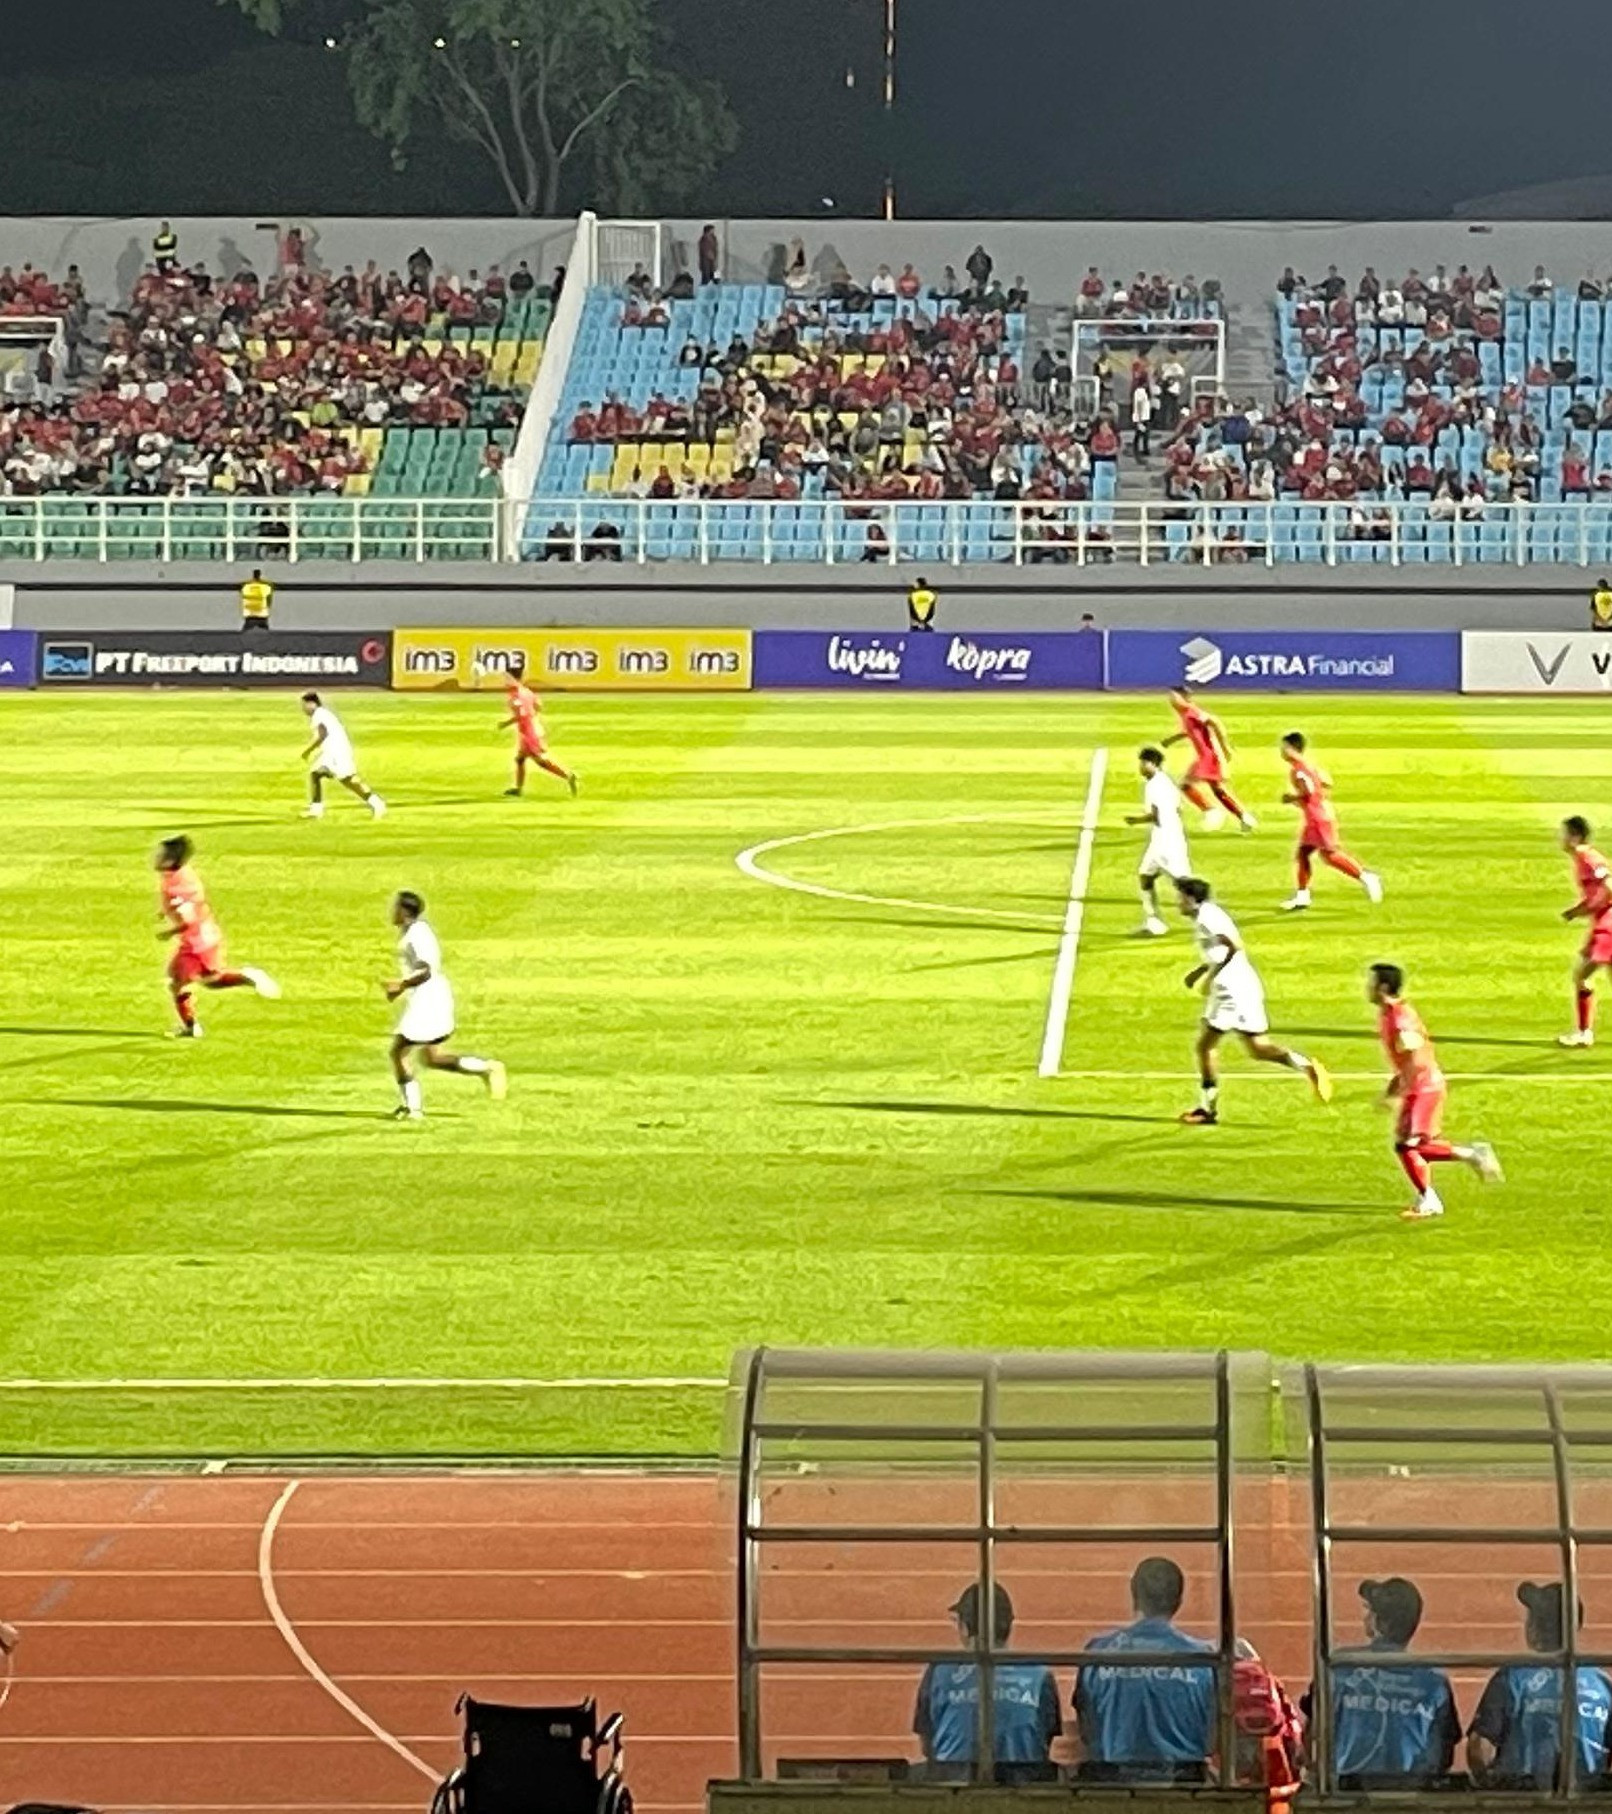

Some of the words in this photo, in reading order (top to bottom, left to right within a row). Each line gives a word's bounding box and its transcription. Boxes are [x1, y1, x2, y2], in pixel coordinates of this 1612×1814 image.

[96, 652, 130, 673] PT
[132, 652, 240, 673] FREEPORT
[242, 652, 358, 673] INDONESIA
[404, 647, 455, 673] im3
[475, 647, 526, 673] im3
[547, 647, 598, 673] im3
[618, 647, 668, 673] im3
[690, 647, 739, 673] im3
[946, 636, 1031, 680] kopra
[1225, 655, 1306, 675] ASTRA
[1308, 654, 1394, 676] Financial
[1099, 1666, 1199, 1685] MEDICAL
